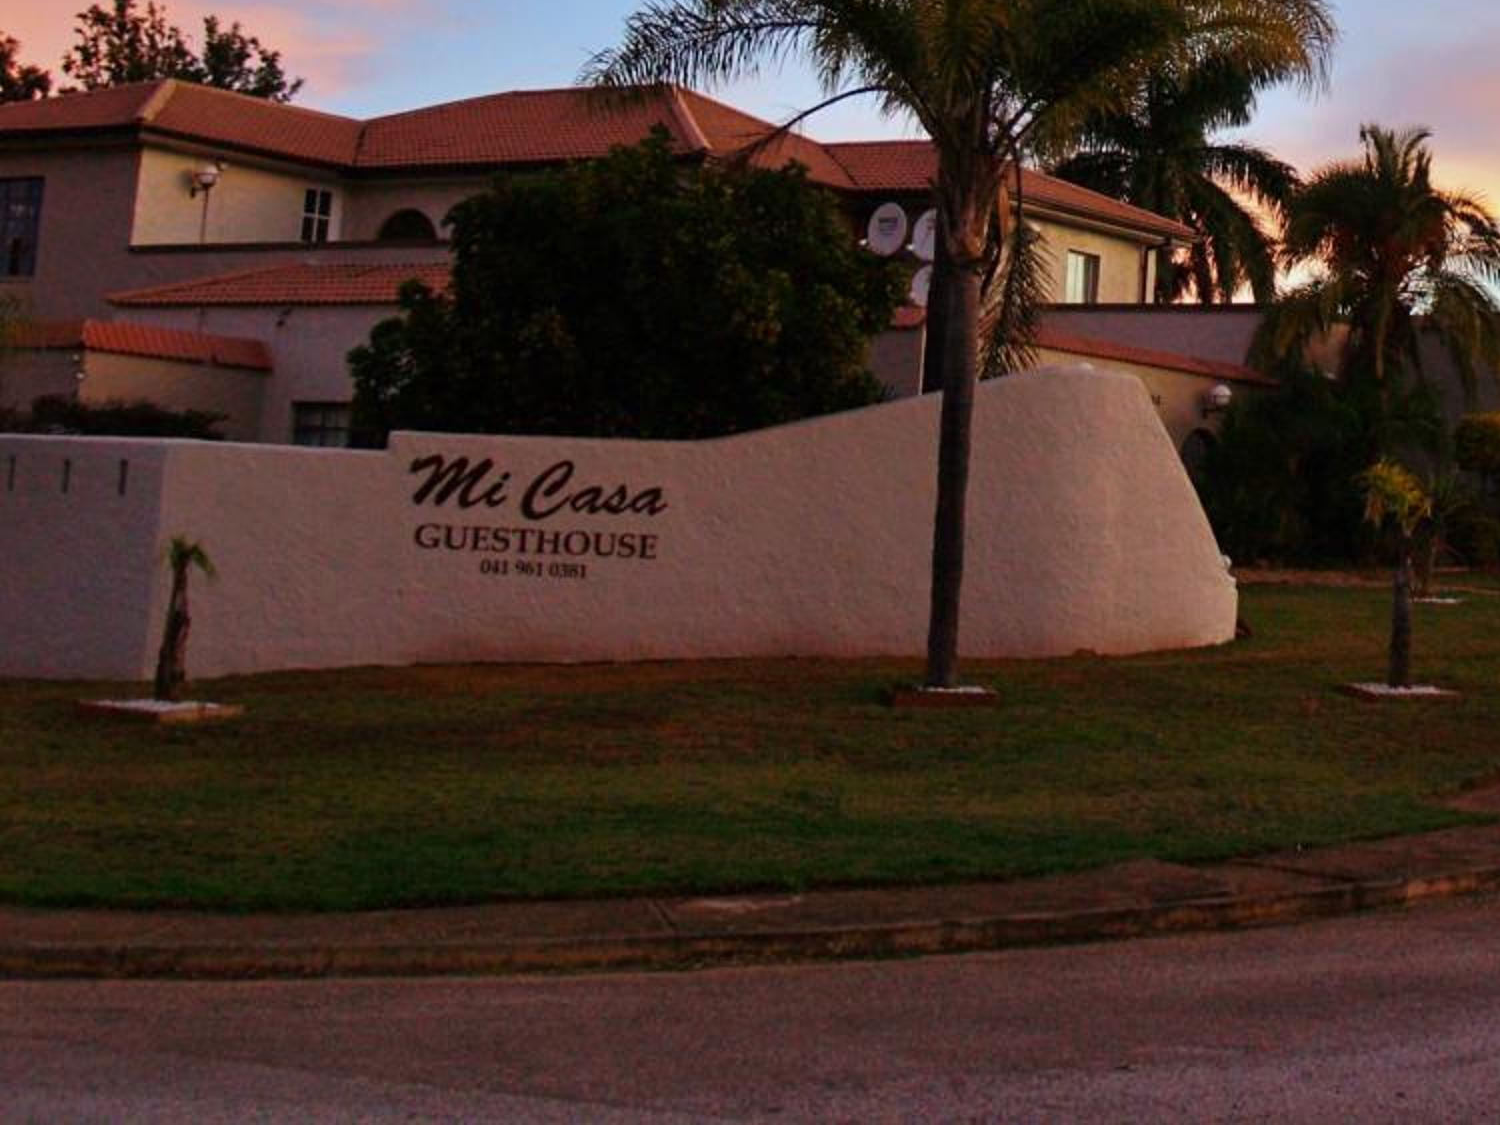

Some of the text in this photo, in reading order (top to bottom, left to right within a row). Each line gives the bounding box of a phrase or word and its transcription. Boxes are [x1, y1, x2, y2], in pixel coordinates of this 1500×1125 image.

[409, 454, 667, 520] Mi Casa
[414, 523, 658, 559] GUESTHOUSE
[479, 559, 508, 576] 041
[515, 560, 543, 577] 961
